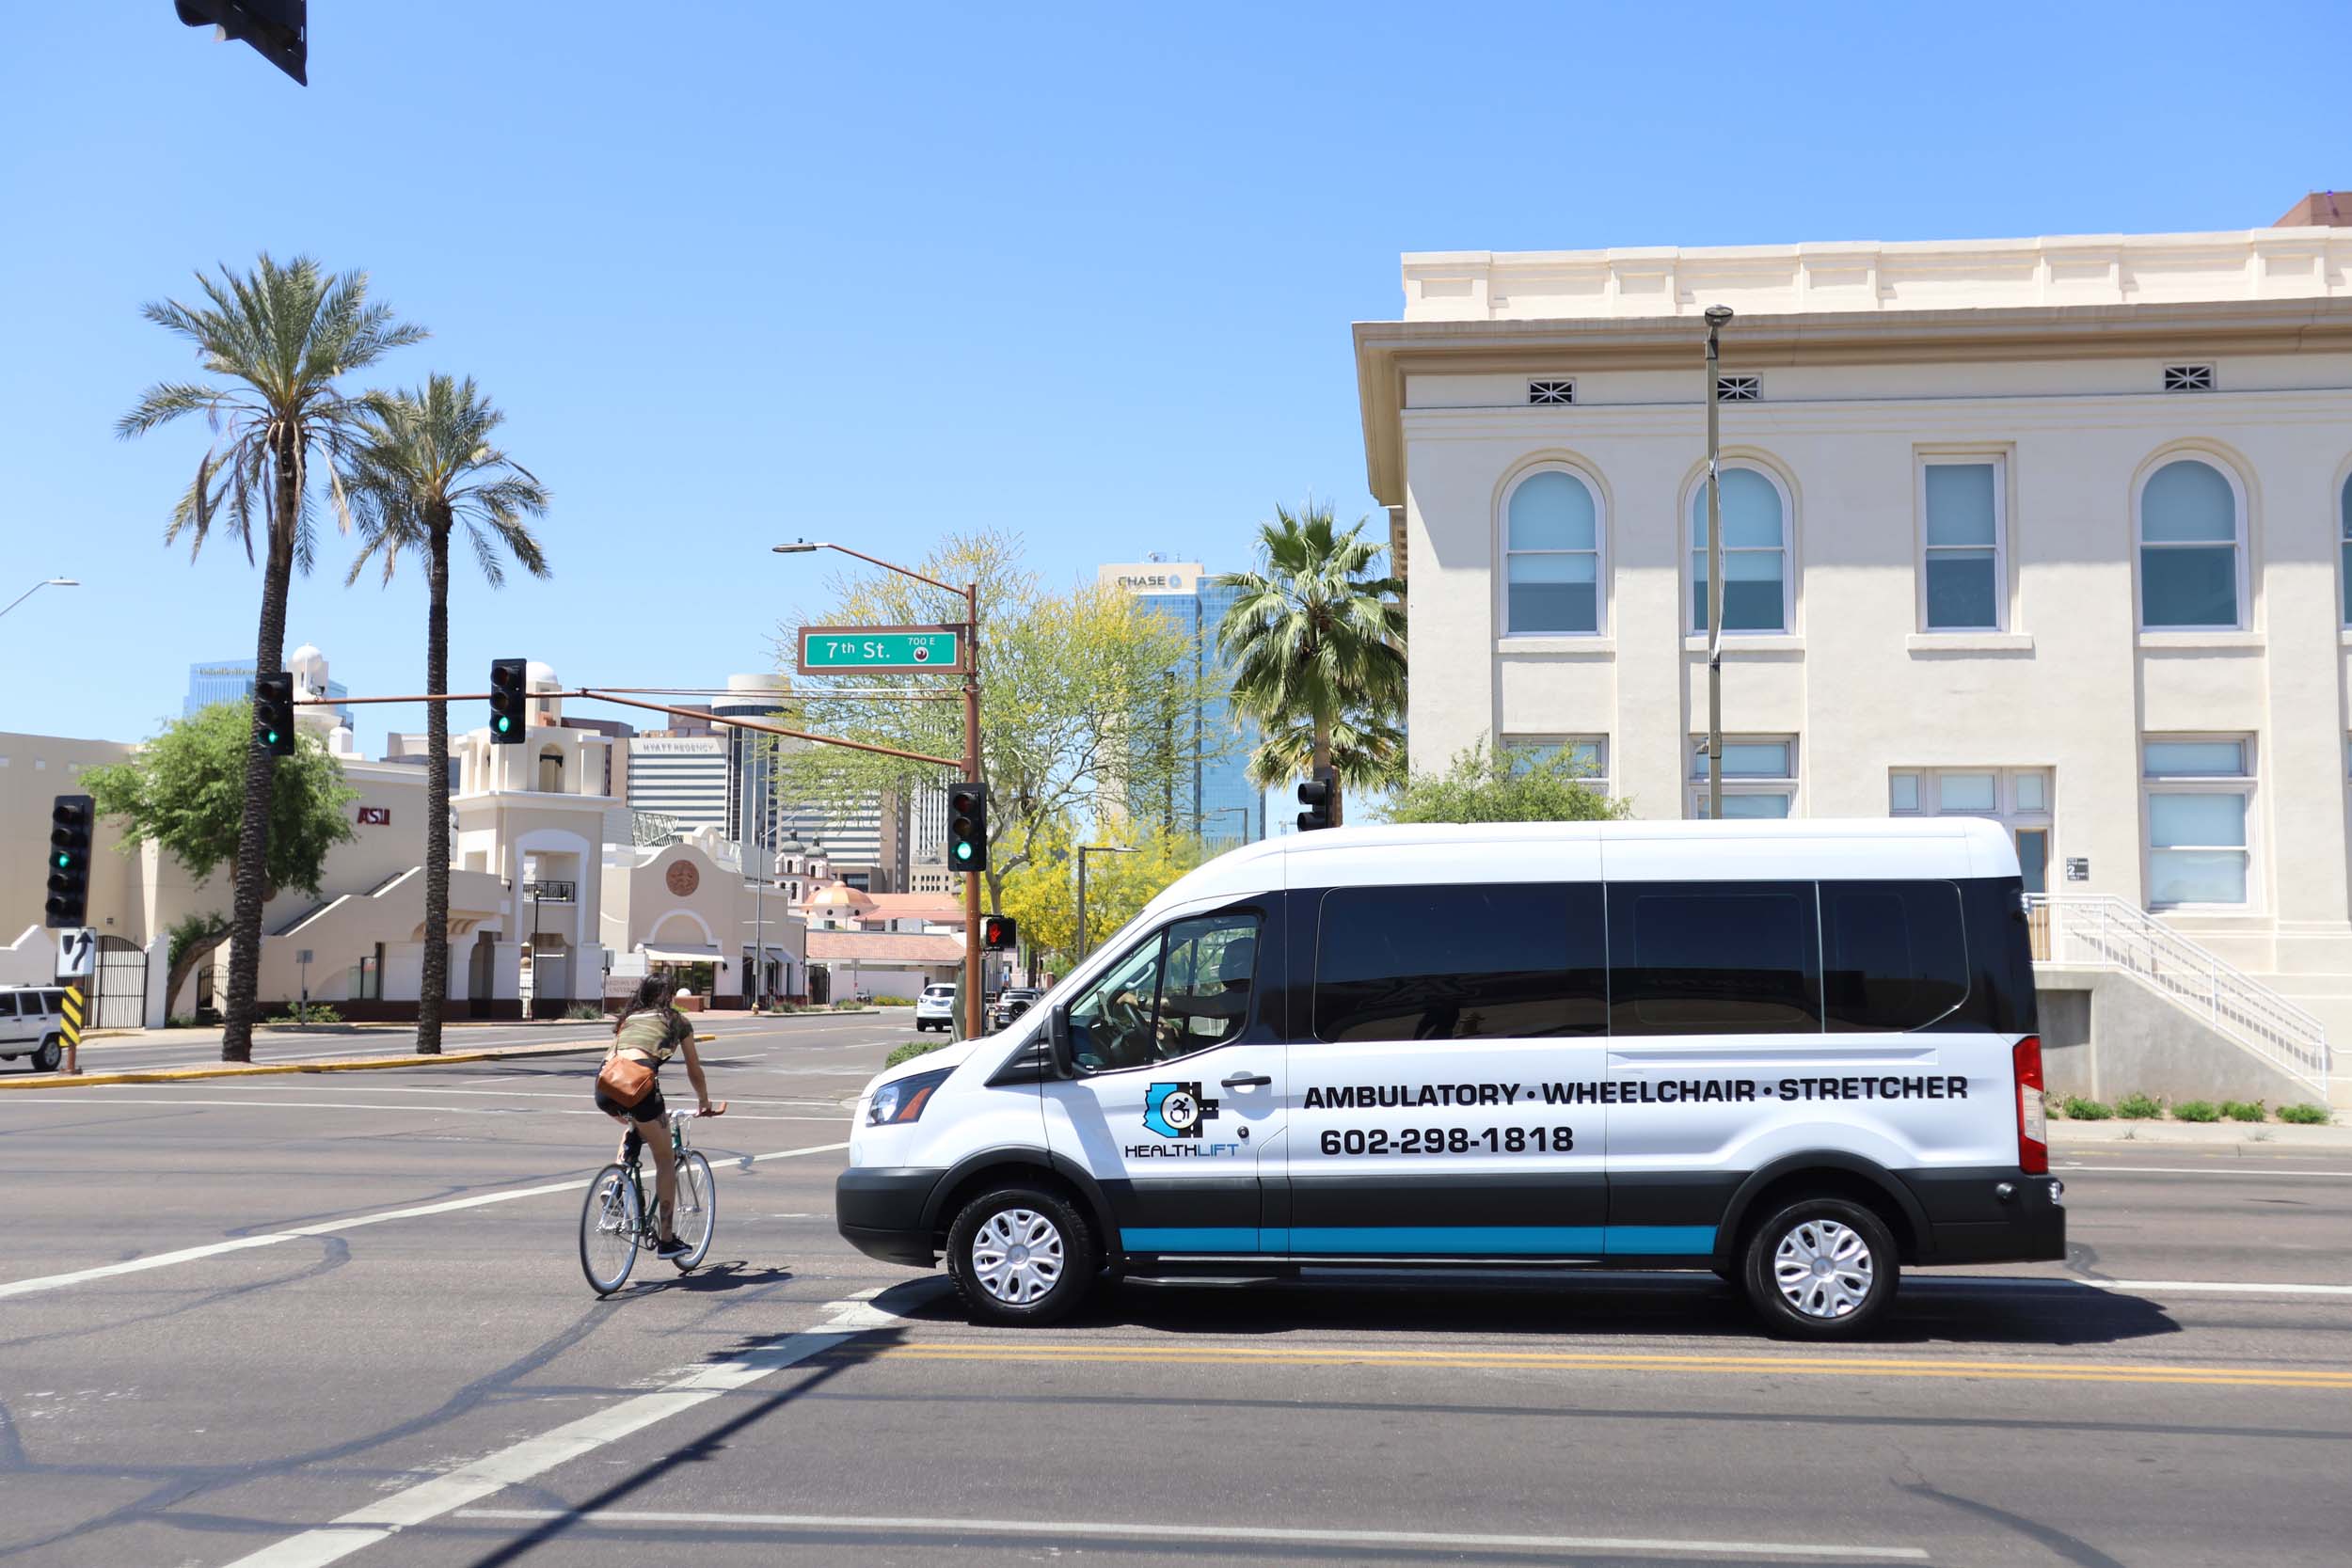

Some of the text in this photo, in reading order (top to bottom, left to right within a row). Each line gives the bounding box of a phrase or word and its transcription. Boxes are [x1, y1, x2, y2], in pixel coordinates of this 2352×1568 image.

[1118, 576, 1166, 586] CHASE
[908, 637, 936, 646] 700 E
[826, 641, 890, 659] 7th St.
[644, 744, 714, 752] HYATT REGENCY
[358, 807, 390, 825] ASU
[2068, 865, 2075, 876] 2
[1304, 1076, 1968, 1109] AMBULATORY WHEELCHAIR STRETCHER
[1320, 1126, 1574, 1155] 602-298-1818
[1125, 1144, 1239, 1158] HEALTHLIFT
